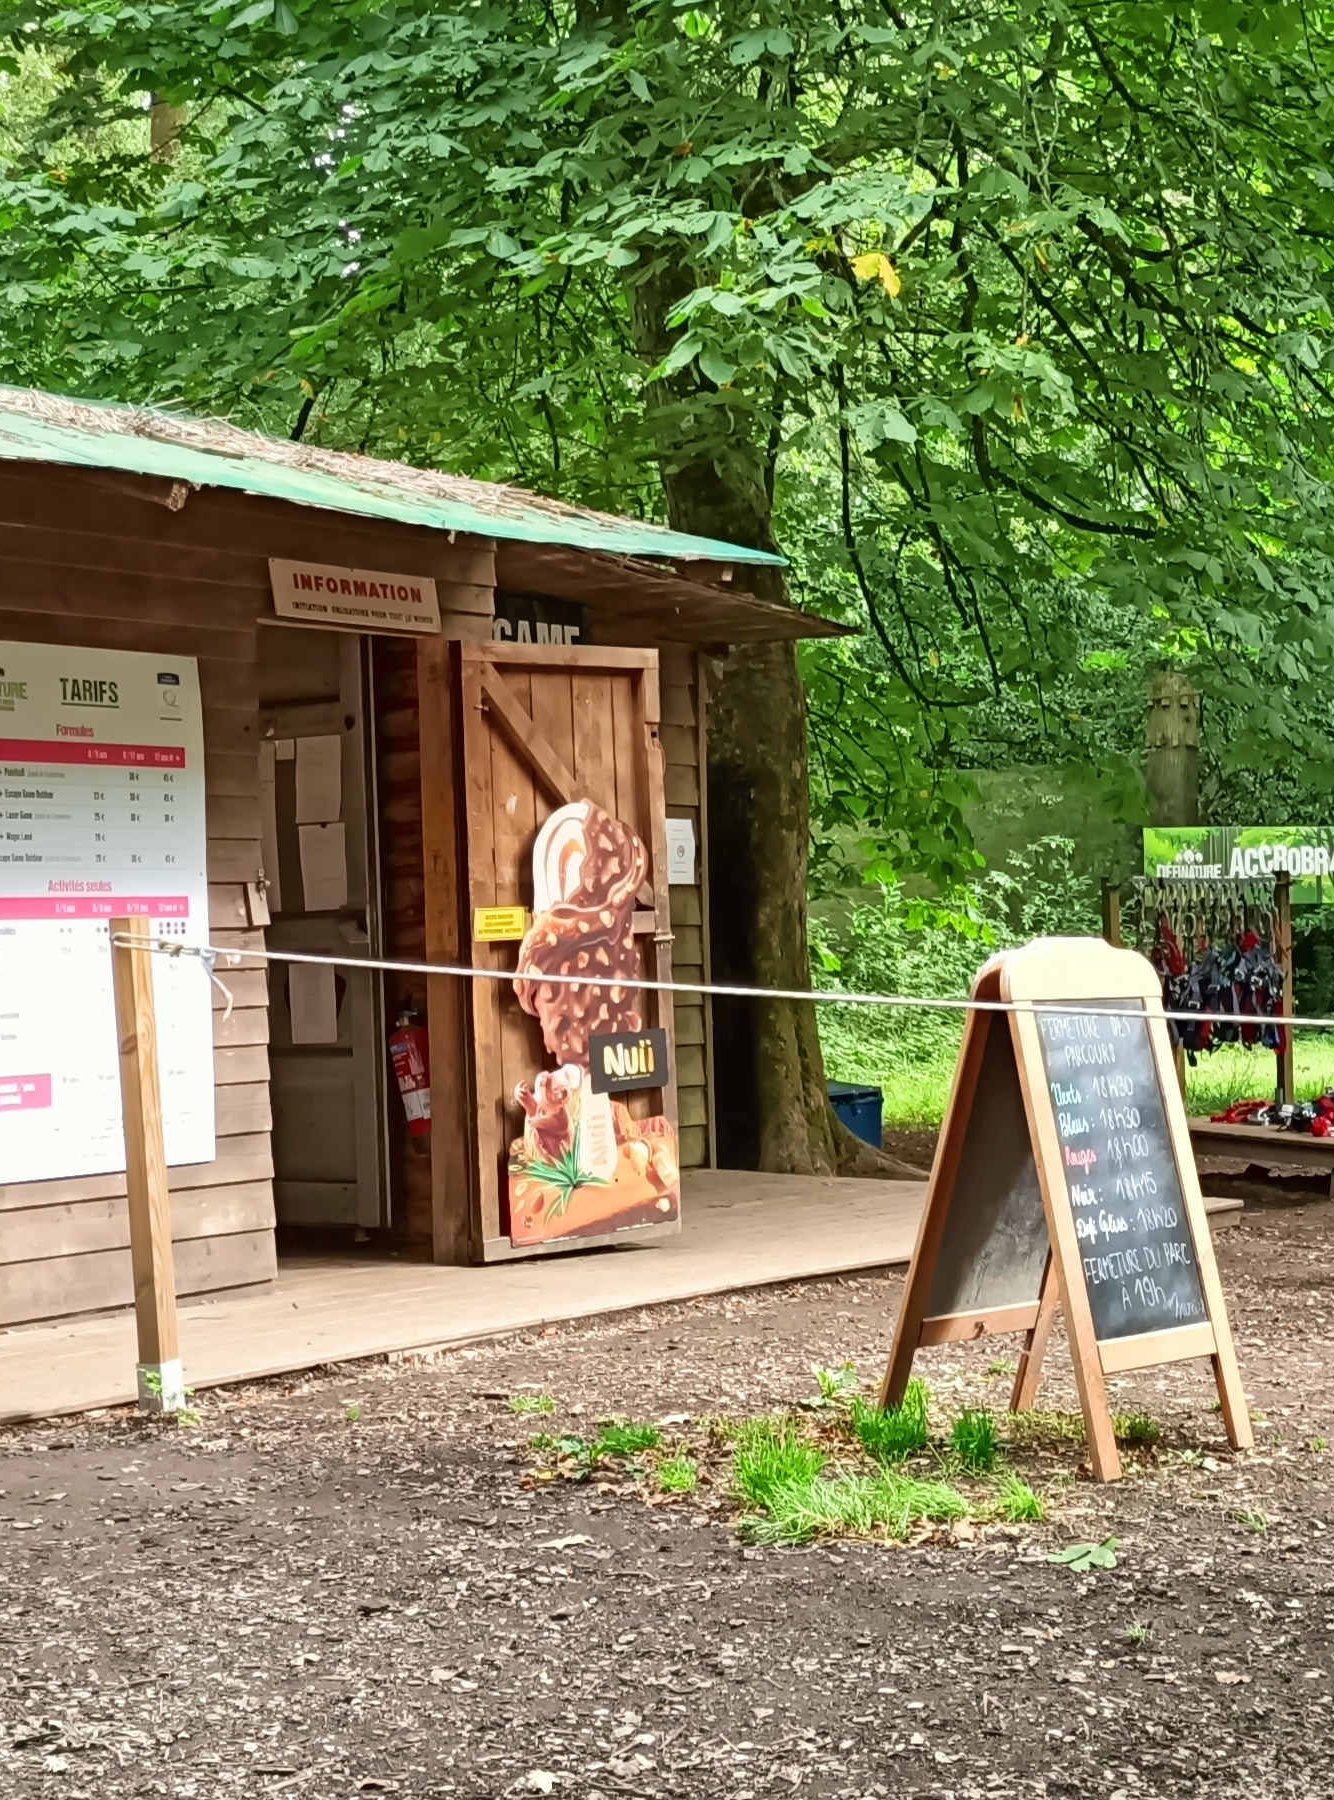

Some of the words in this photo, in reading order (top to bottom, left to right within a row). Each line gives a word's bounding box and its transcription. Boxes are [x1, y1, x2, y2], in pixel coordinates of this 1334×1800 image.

[292, 573, 423, 603] INFORMATION
[59, 677, 119, 704] TARIFS
[56, 723, 94, 738] Formules
[48, 880, 85, 892] Activités
[86, 880, 112, 892] seules
[1040, 1015, 1101, 1041] FERMETURE
[1109, 1015, 1131, 1038] DES
[603, 1039, 655, 1076] Nuii
[1065, 1043, 1116, 1068] PARCOURS
[1093, 1075, 1134, 1099] 18h30
[1099, 1107, 1141, 1130] 18h30
[1107, 1134, 1149, 1168] 18h00
[1116, 1171, 1158, 1201] 18h15
[1137, 1205, 1178, 1232] 18h20
[1083, 1248, 1142, 1284] FERMETURE
[1143, 1246, 1162, 1270] DU
[1162, 1242, 1191, 1267] PARC
[1134, 1275, 1168, 1308] 19h
